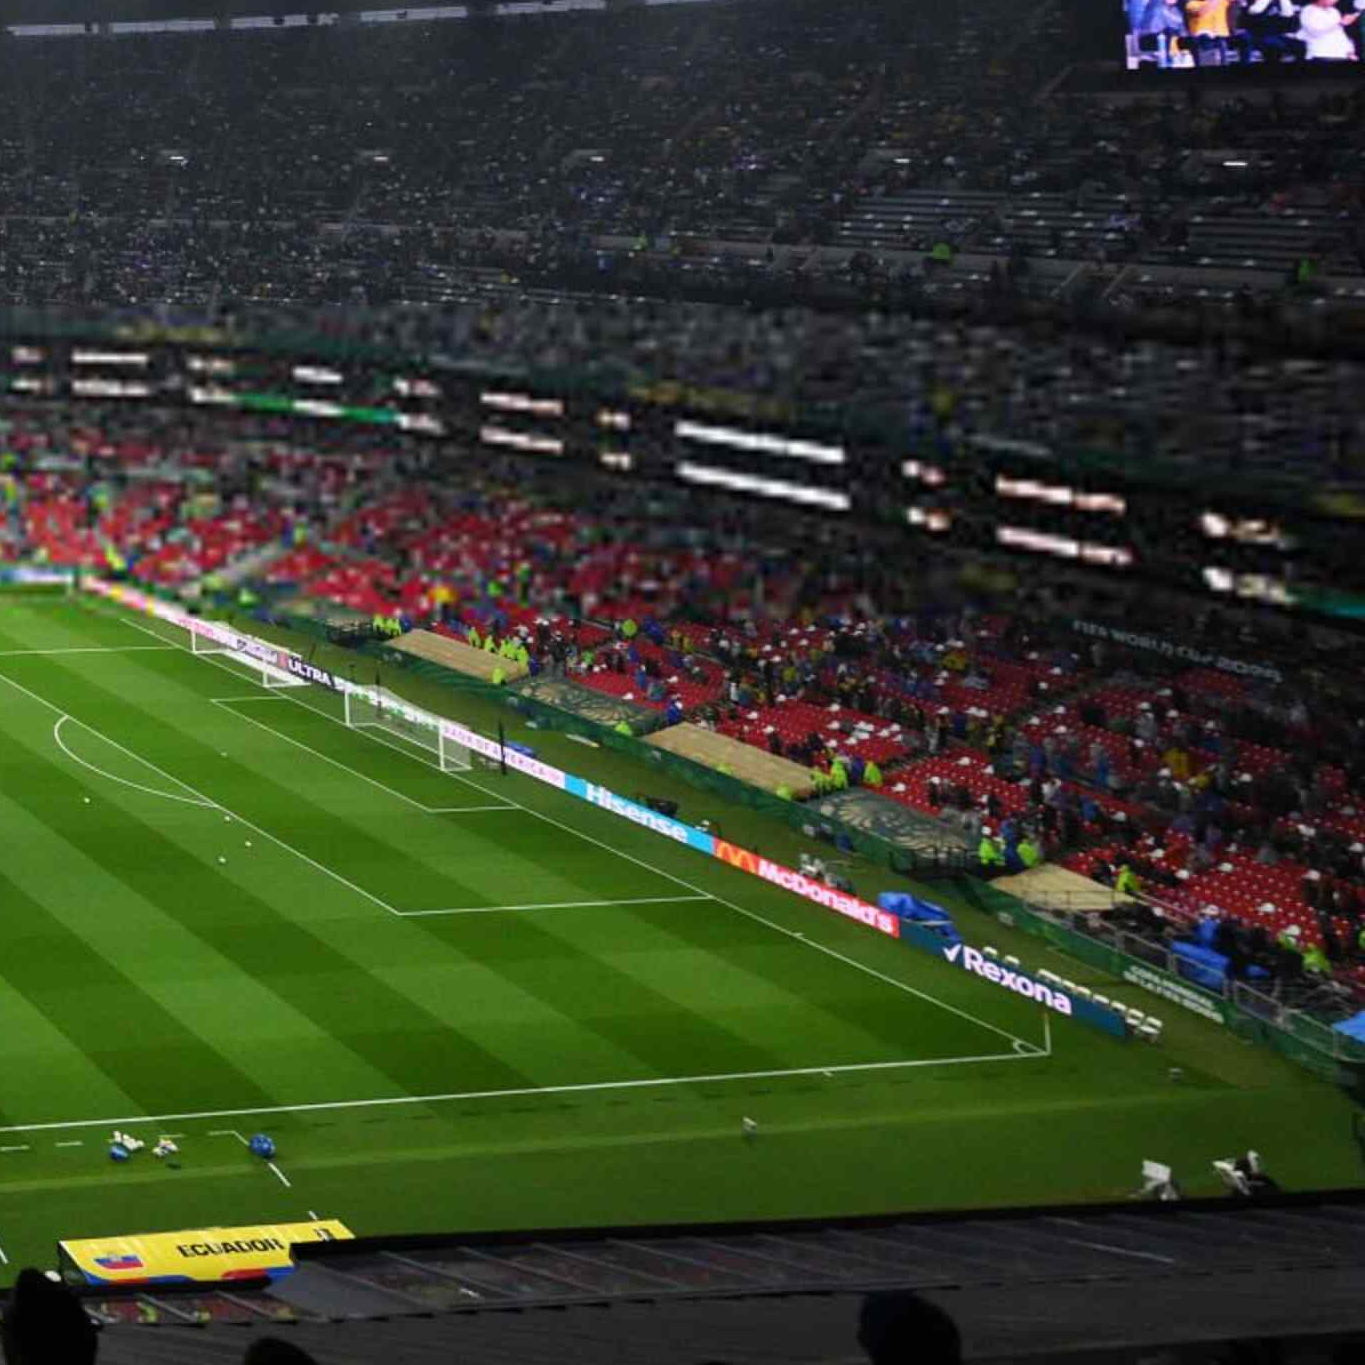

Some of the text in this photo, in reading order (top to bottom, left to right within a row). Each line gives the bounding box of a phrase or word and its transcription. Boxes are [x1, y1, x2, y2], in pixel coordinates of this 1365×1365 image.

[1073, 618, 1108, 637] FIFA
[288, 657, 332, 686] ULTRA
[586, 781, 689, 844] Hisense
[757, 858, 894, 934] McDonald's
[962, 945, 1073, 1016] Rexona
[176, 1238, 285, 1258] ECUADOR
